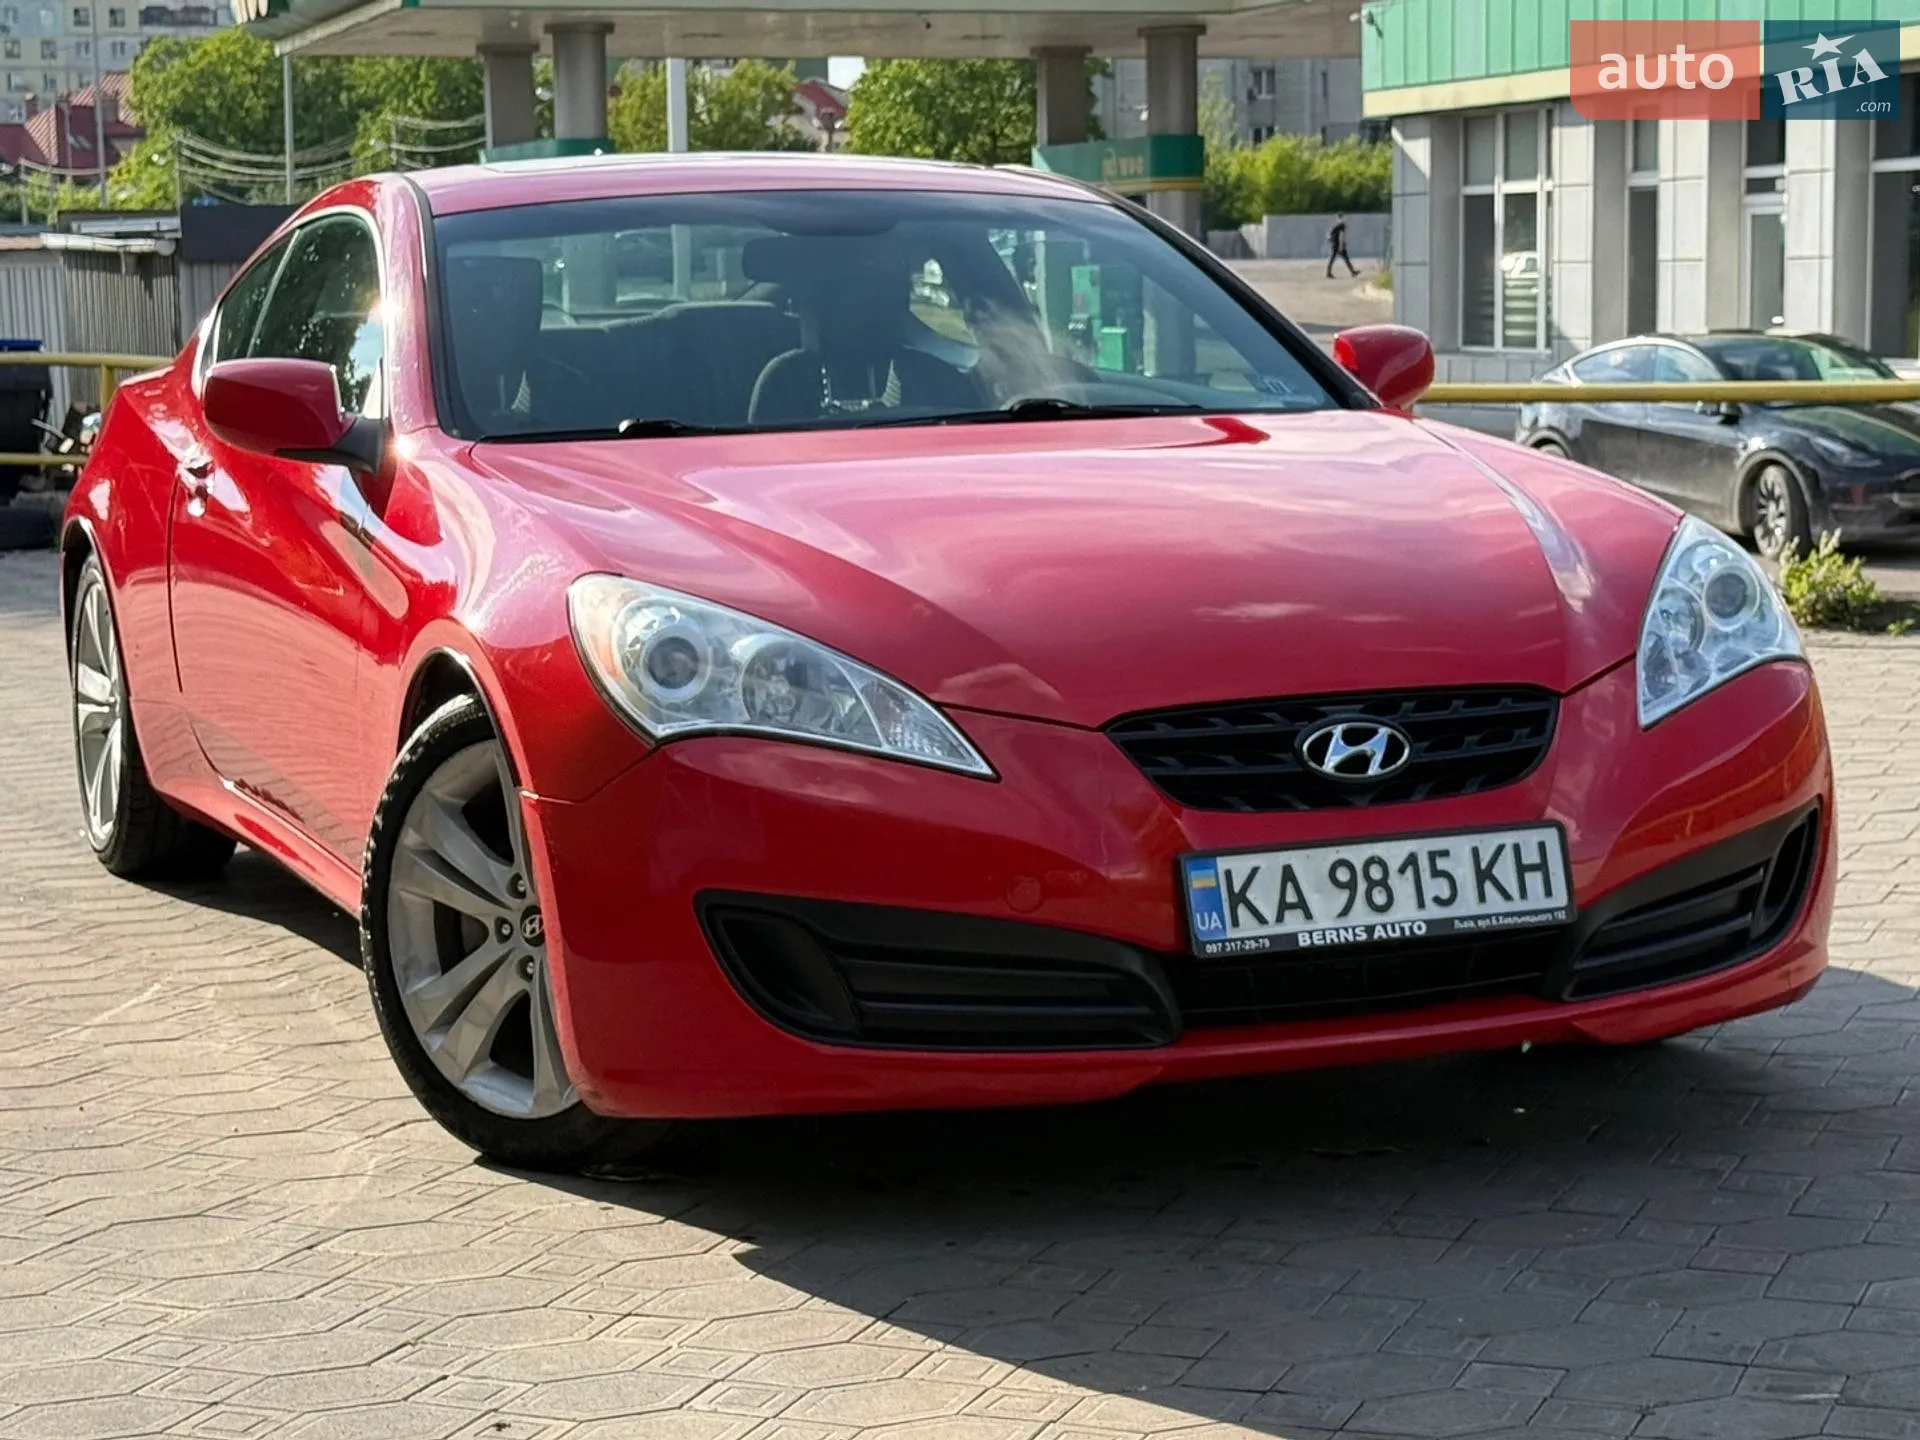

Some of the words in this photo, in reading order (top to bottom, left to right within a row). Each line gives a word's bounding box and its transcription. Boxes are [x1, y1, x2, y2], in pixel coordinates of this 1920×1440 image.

[1224, 863, 1313, 929] KA
[1328, 849, 1458, 918] 9815
[1471, 840, 1553, 904] KH
[1195, 912, 1223, 932] UA
[1297, 926, 1368, 947] BERNS
[1373, 920, 1427, 940] AUTO
